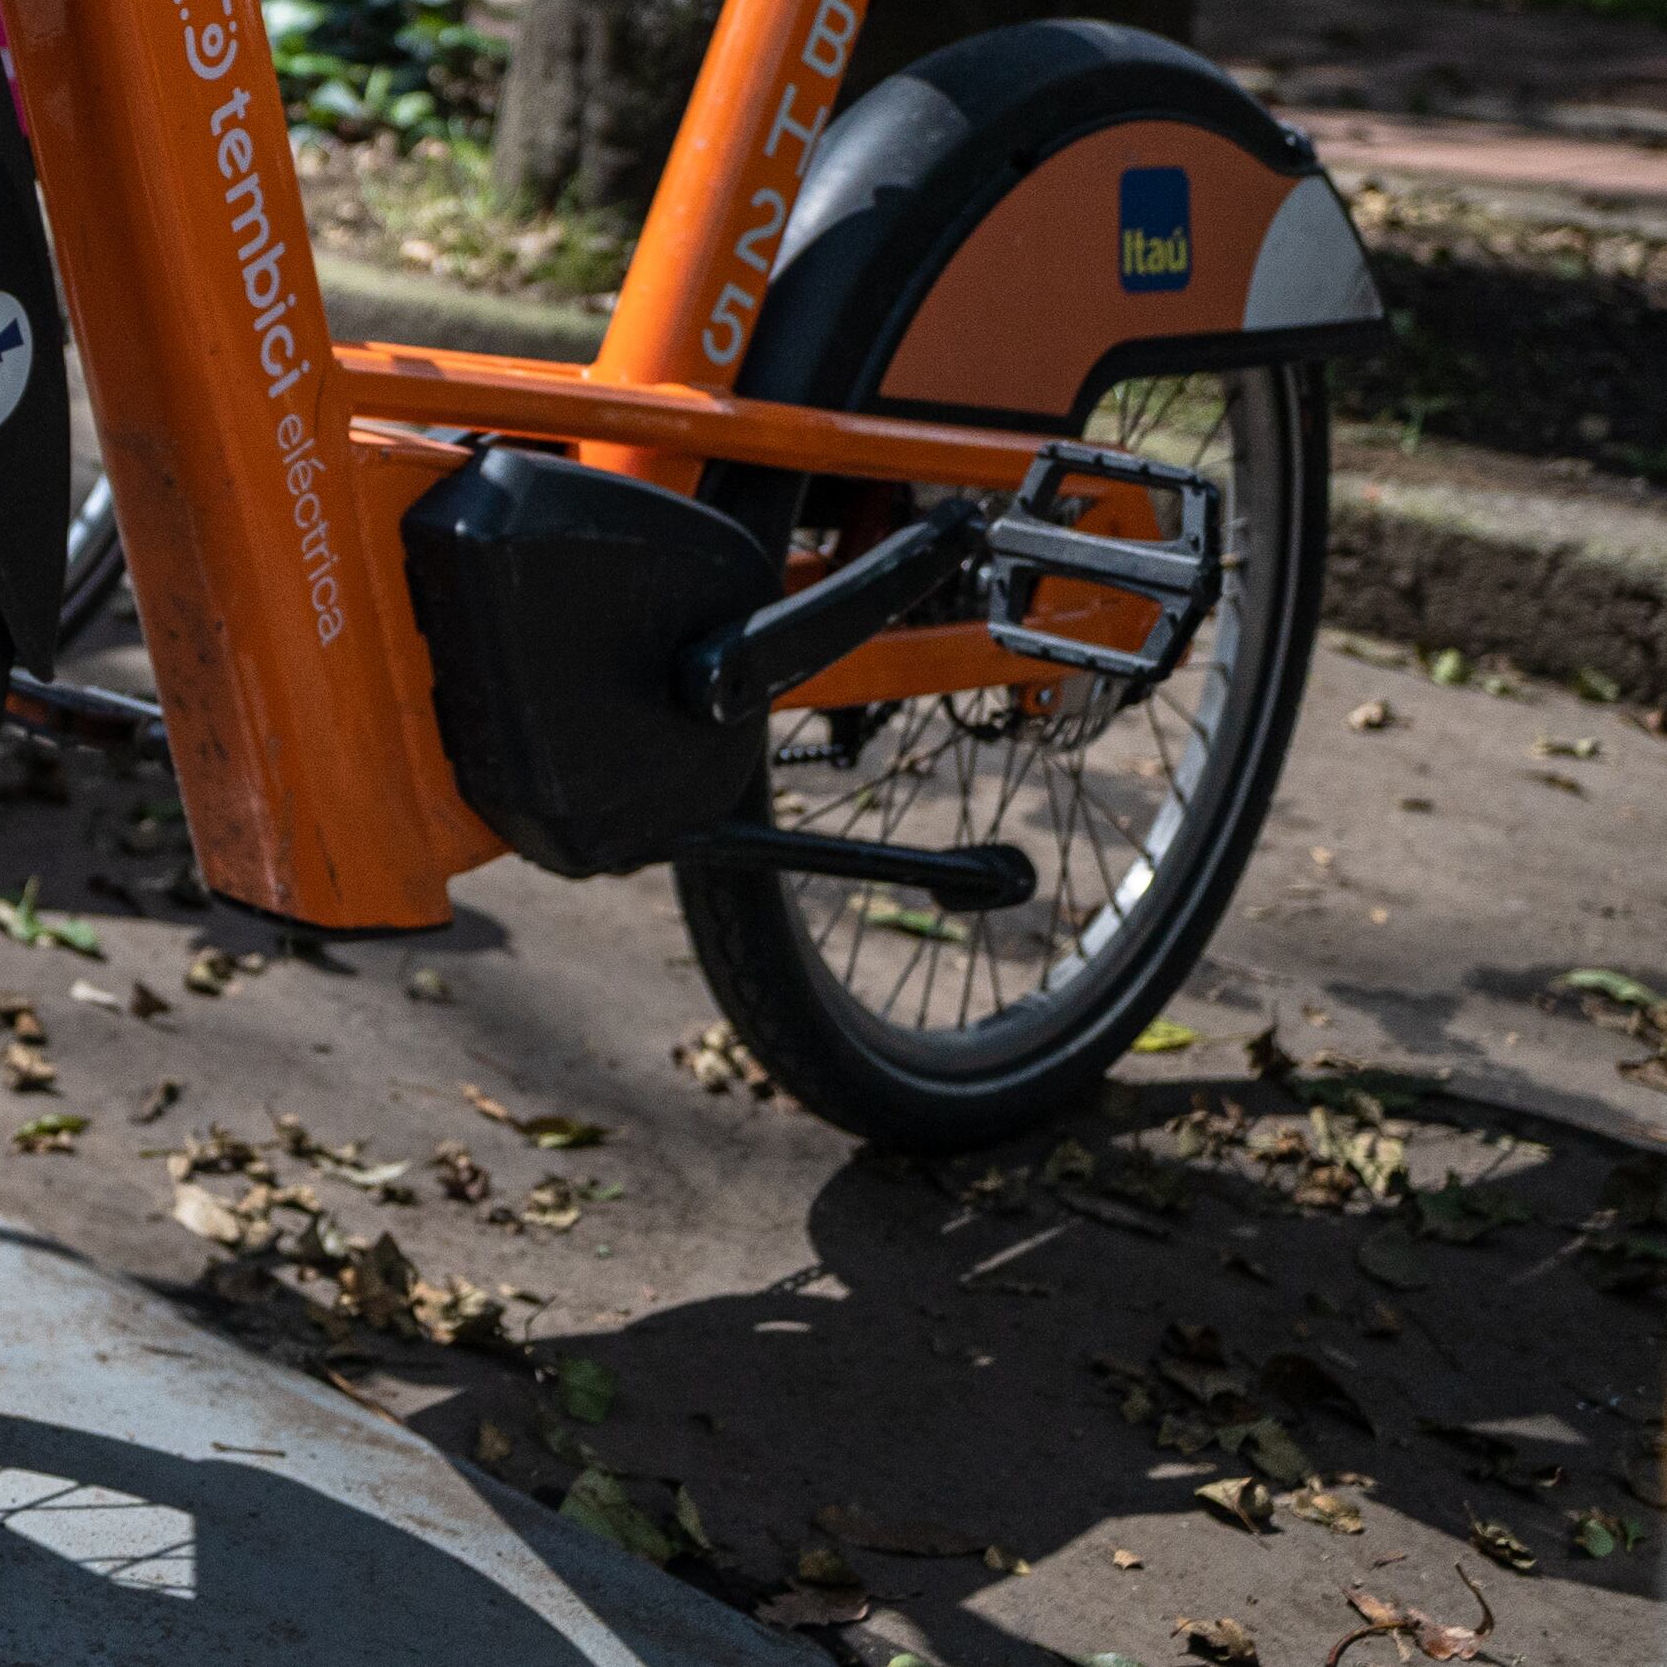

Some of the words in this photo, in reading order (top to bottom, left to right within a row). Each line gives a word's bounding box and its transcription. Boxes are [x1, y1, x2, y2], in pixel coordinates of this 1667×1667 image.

[210, 86, 311, 399] tembici
[276, 413, 345, 647] eléctrica
[1121, 226, 1189, 277] Itaú
